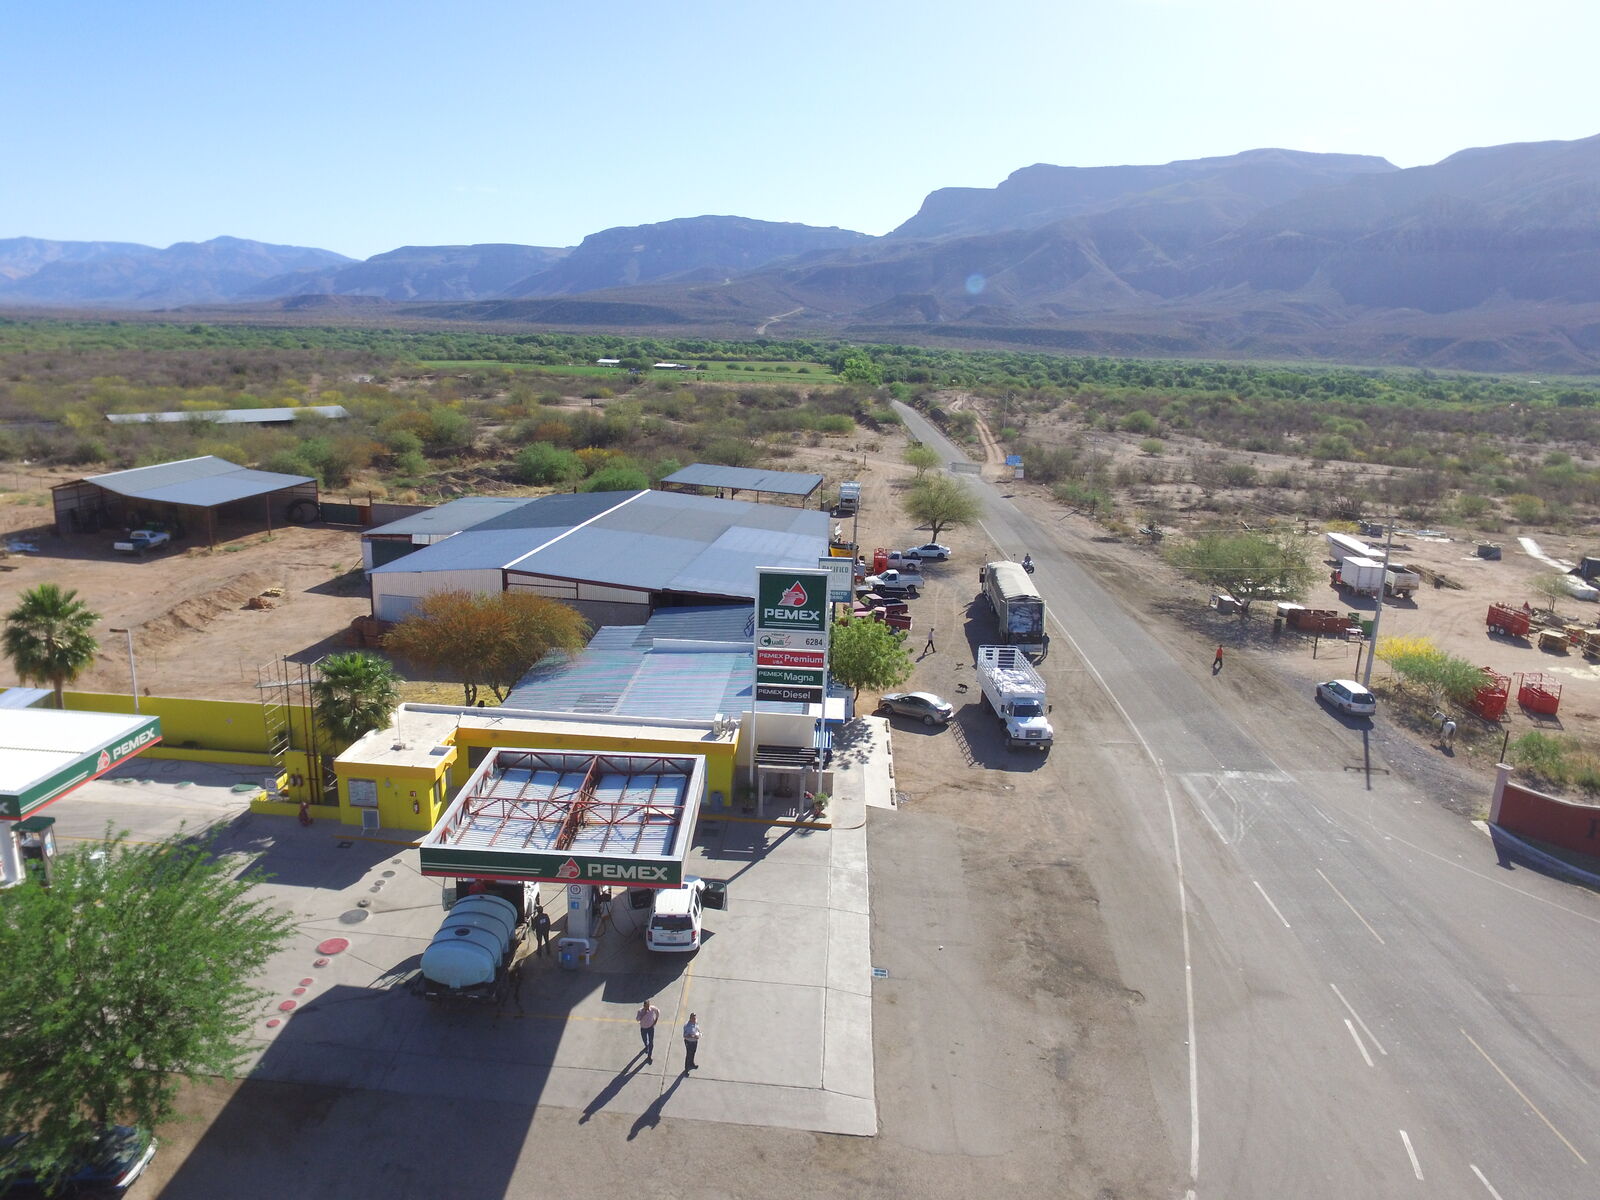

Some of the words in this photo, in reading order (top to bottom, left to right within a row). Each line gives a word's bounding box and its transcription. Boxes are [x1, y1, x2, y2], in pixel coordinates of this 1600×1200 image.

[764, 608, 820, 621] PEMEX
[805, 638, 823, 646] 6284
[784, 654, 823, 664] Premium
[783, 672, 815, 683] Magna
[782, 690, 811, 699] Diesel
[112, 727, 156, 760] PEMEX
[587, 863, 668, 880] PEMEX
